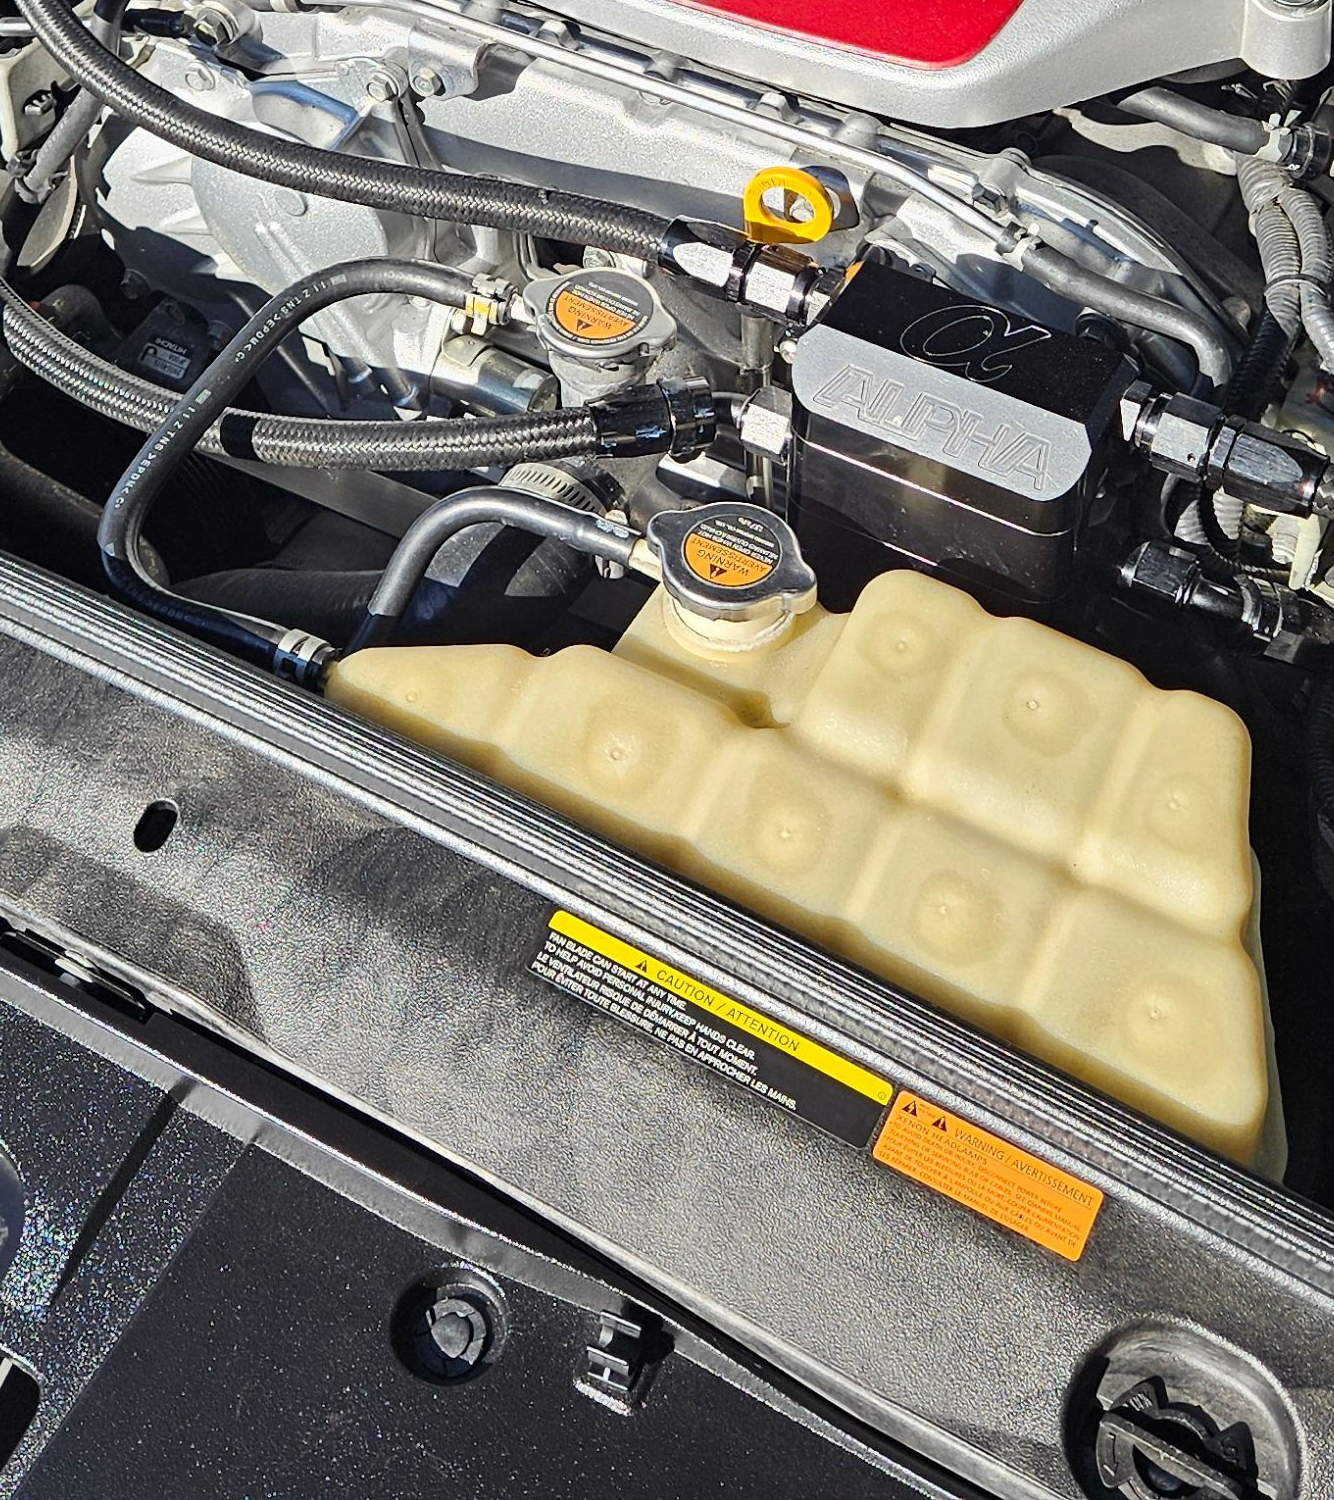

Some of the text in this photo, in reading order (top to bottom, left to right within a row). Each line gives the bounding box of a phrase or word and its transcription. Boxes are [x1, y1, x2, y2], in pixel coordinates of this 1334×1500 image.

[564, 295, 629, 327] AVERTISSEMENT
[567, 306, 612, 330] WARNING
[812, 363, 1053, 491] ALPHA
[691, 538, 767, 572] AVERTISSEMENT
[697, 549, 749, 575] WARNING
[542, 940, 557, 954] TO
[554, 946, 579, 965] HELP
[576, 958, 603, 978] AVOID
[601, 971, 647, 1002] PERSONAL
[694, 1021, 727, 1045] HANDS
[724, 1037, 757, 1061] CLEAR.
[547, 931, 689, 1011] FAN BLADE CAN START AT ANY TIME.
[655, 968, 715, 1007] CAUTION
[725, 1005, 801, 1052] ATTENTION
[530, 959, 557, 980] POUR
[554, 970, 585, 994] ÉVITER
[582, 987, 611, 1009] TOUTE
[608, 1001, 655, 1033] BLESSURE,
[653, 1026, 669, 1040] NE
[666, 1033, 686, 1049] PAS
[683, 1042, 699, 1057] EN
[695, 1049, 752, 1085] APPROCHER
[749, 1077, 769, 1094] LES
[536, 950, 549, 963] LE
[546, 956, 600, 990] VENTILATEUR
[597, 983, 631, 1007] RISQUE
[629, 1000, 643, 1014] DE
[641, 1004, 692, 1040] DÉMARRER
[695, 1035, 720, 1055] TOUT
[717, 1047, 759, 1076] MOMENT.
[895, 1113, 988, 1165] XENON HEADLAMPS
[953, 1127, 1005, 1160] WARNING
[1010, 1156, 1095, 1207] AVERTISSEMENT
[1016, 1184, 1039, 1200] POWER
